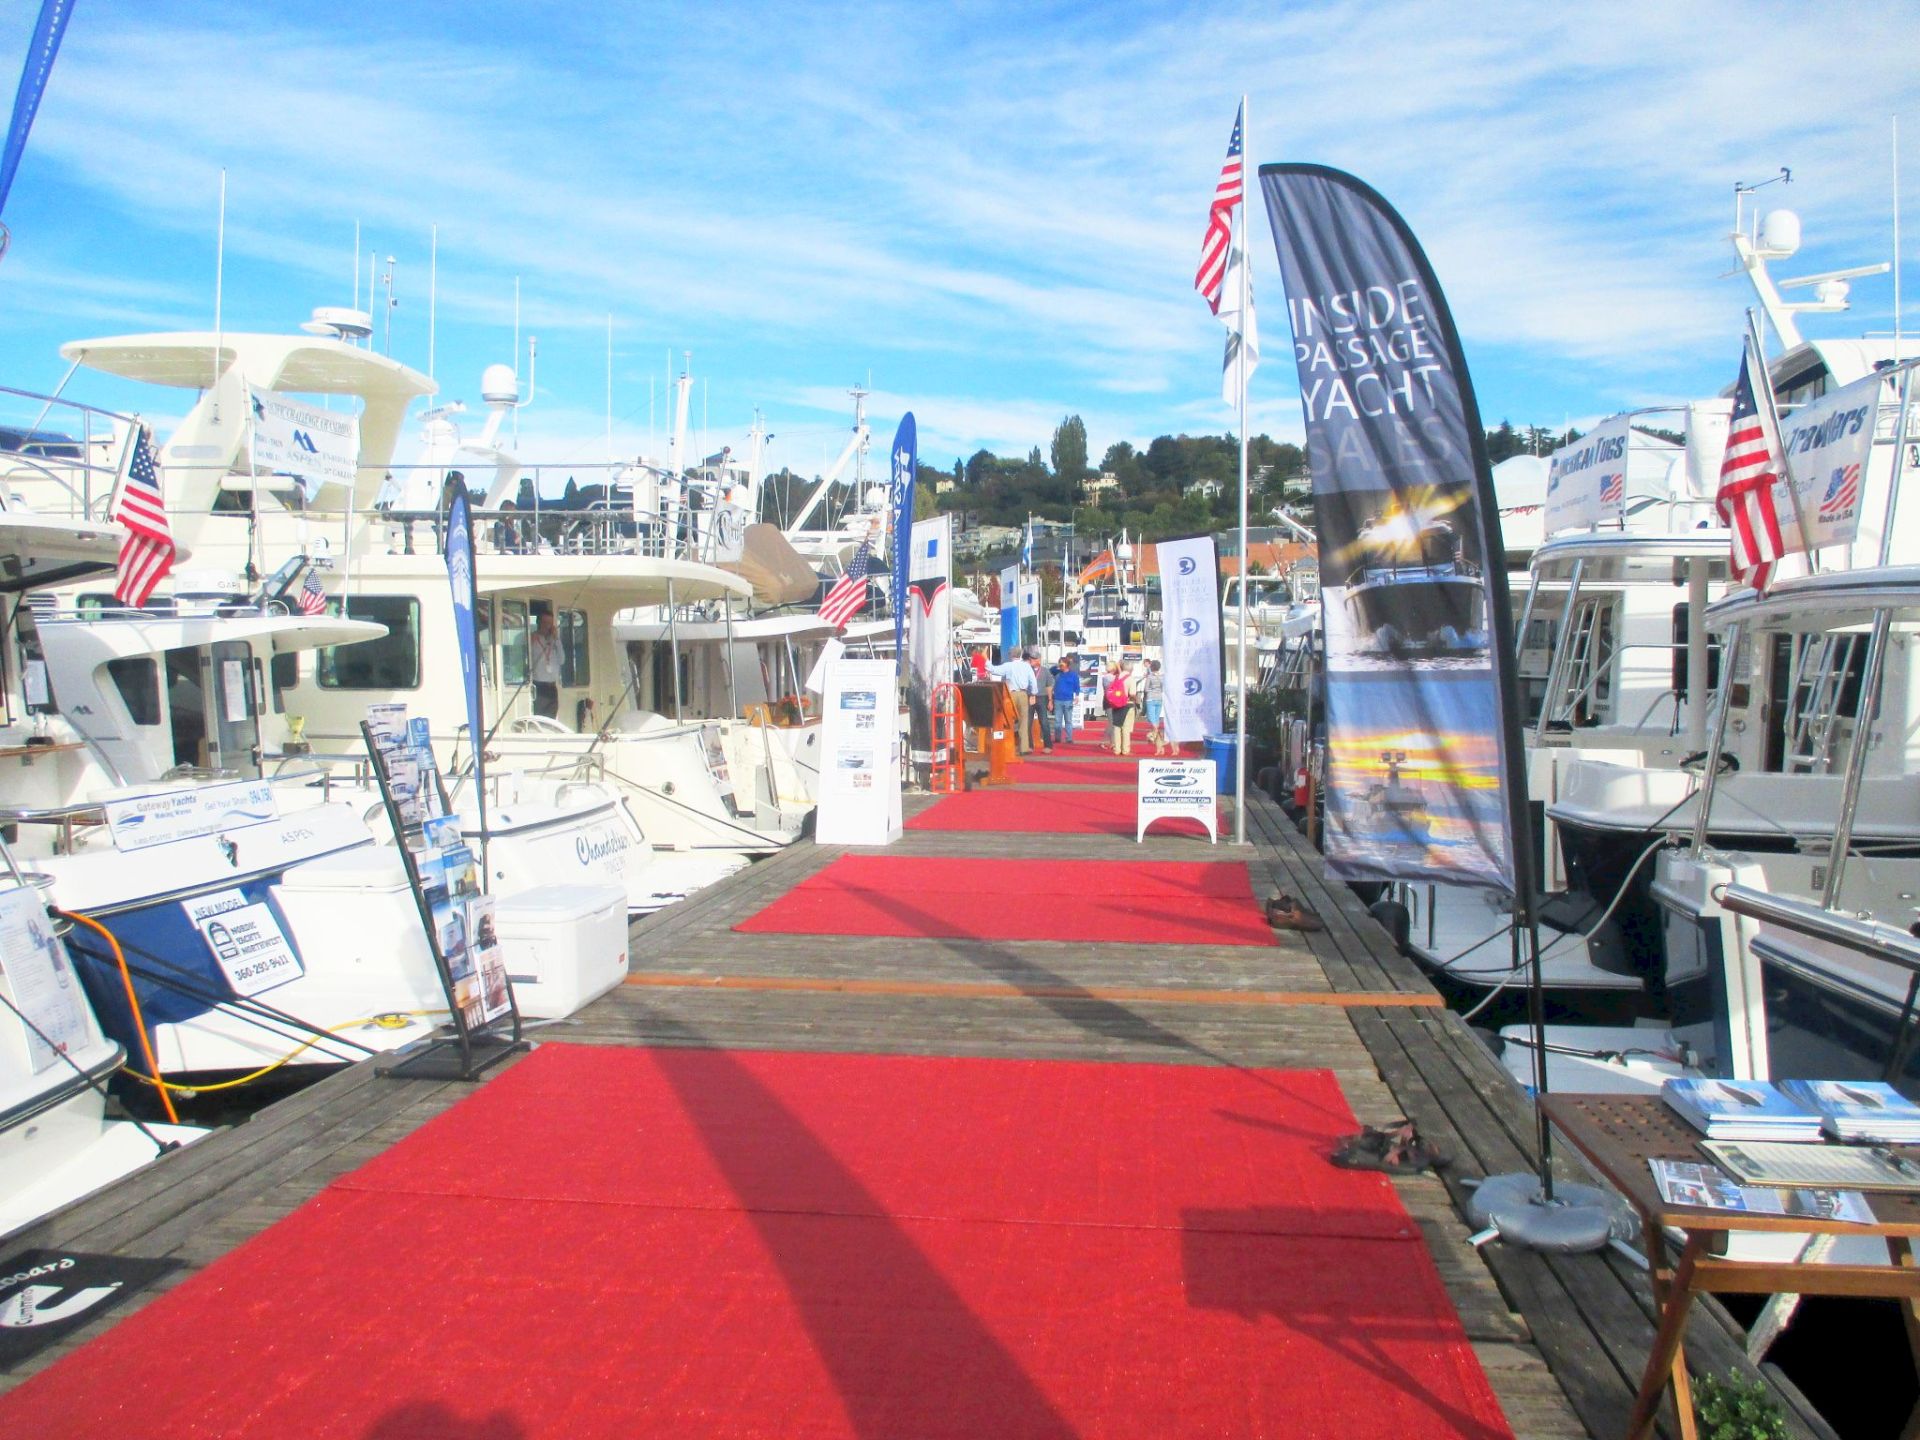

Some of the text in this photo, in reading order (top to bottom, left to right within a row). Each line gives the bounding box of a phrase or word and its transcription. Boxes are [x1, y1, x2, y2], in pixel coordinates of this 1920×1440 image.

[1288, 279, 1425, 338] INSIDE
[1296, 329, 1434, 372] PASSAGE
[1302, 365, 1441, 423] YACHT
[136, 795, 197, 813] Gateway Yachts
[281, 828, 315, 845] ASPEN
[235, 932, 262, 945] YACHTS
